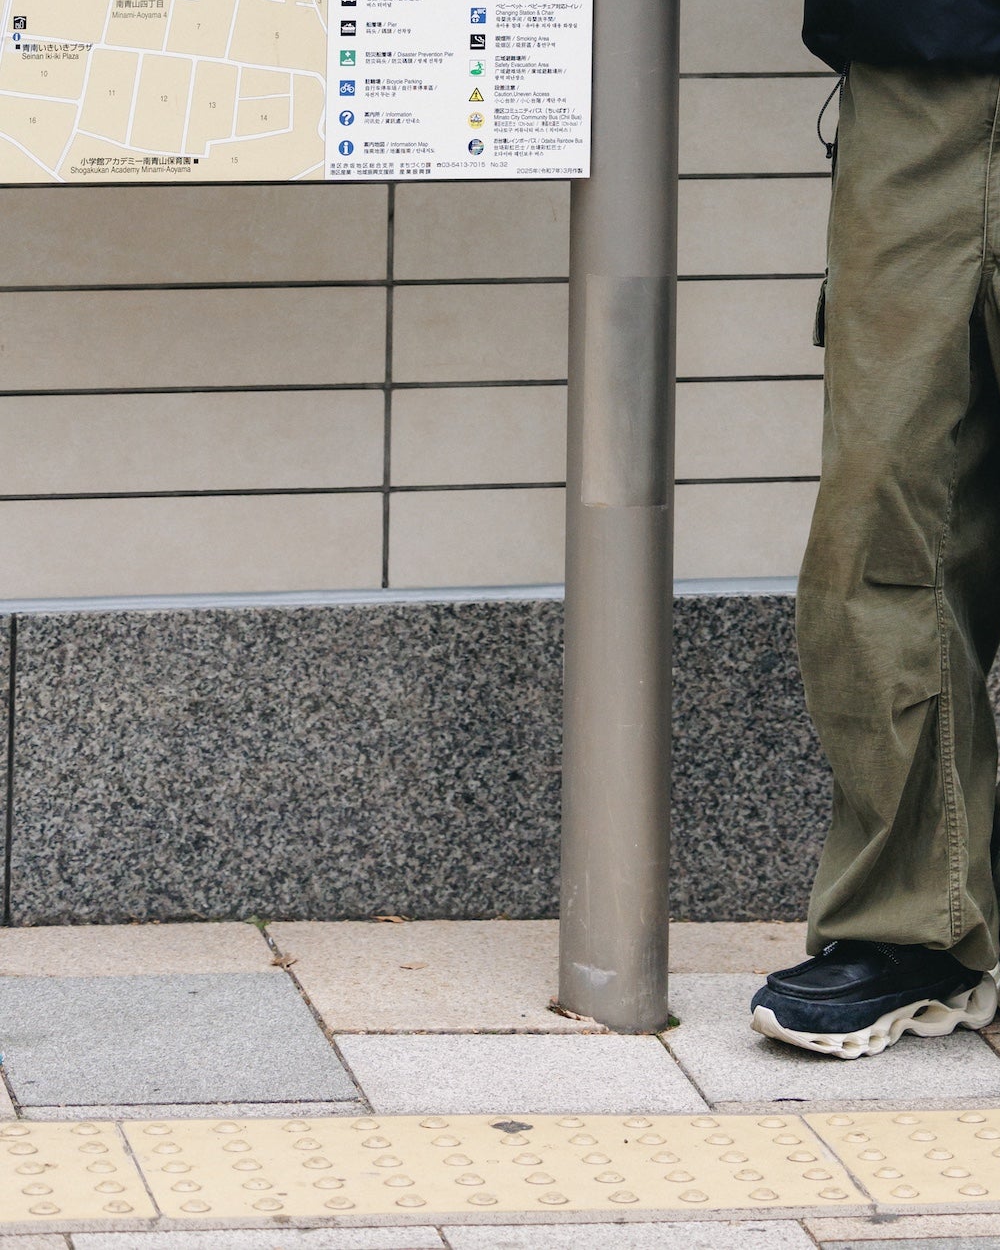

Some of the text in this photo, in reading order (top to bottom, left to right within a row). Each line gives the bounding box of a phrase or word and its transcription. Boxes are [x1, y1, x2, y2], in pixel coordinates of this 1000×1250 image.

[116, 0, 164, 8] 南青山四丁目
[112, 11, 161, 20] Minami-Aoyama
[22, 43, 93, 52] 青南いきいきプラザ
[80, 157, 191, 165] 小学館アカデミー南青山保育園
[71, 166, 191, 175] Shogakukan Academy Minami-Aoyama
